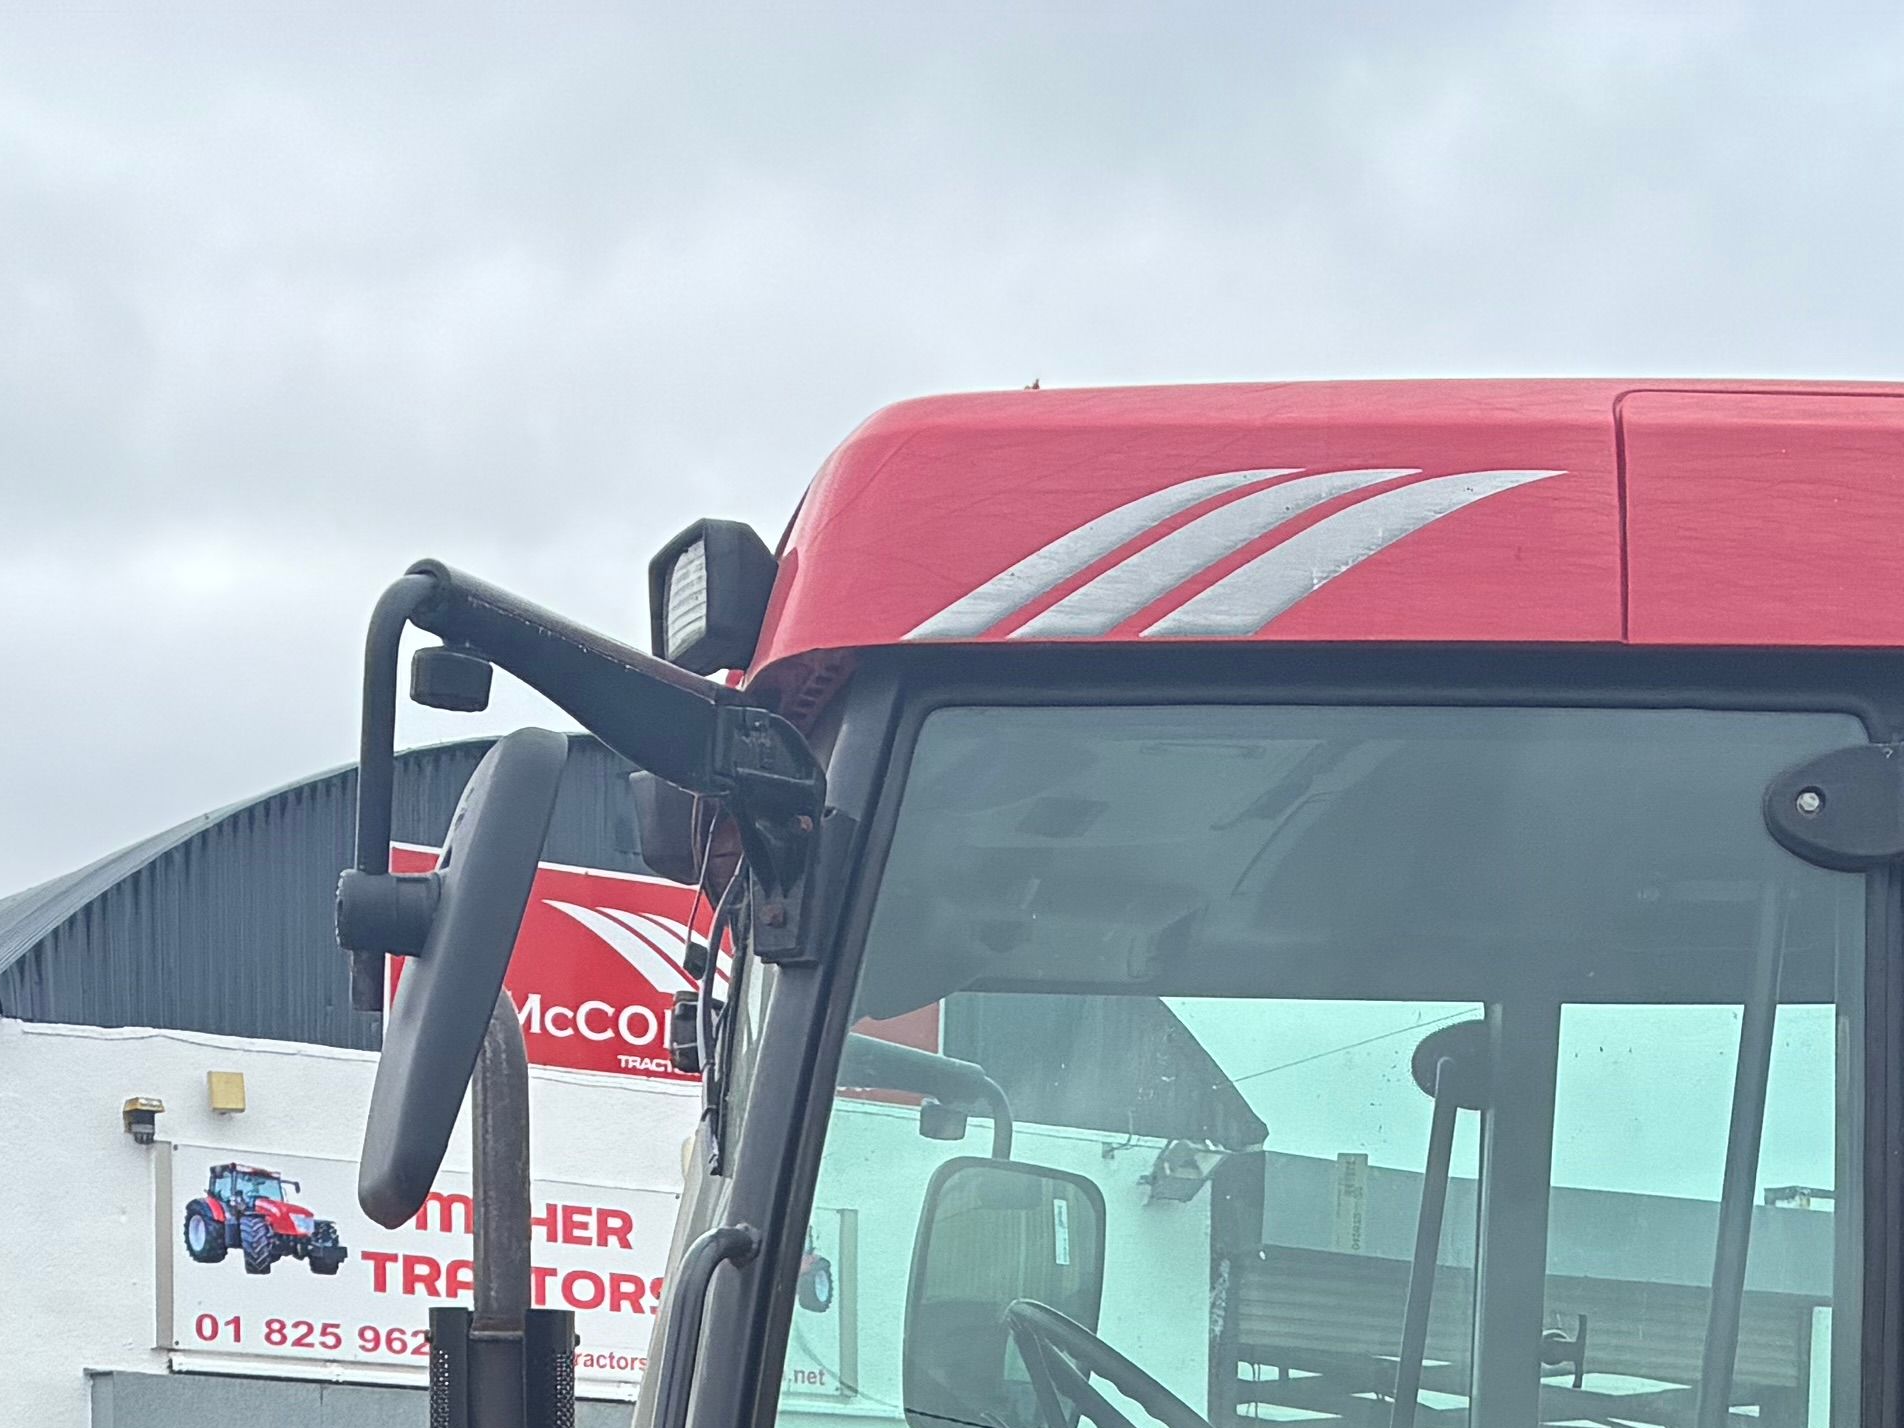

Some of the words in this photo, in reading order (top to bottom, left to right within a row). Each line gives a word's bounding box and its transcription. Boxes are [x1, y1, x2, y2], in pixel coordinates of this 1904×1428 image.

[507, 989, 672, 1049] McCO
[414, 1190, 634, 1250] MHER
[360, 1249, 664, 1315] TRATORS
[194, 1312, 243, 1344] 01
[263, 1318, 343, 1351] 825
[357, 1324, 430, 1357] 962
